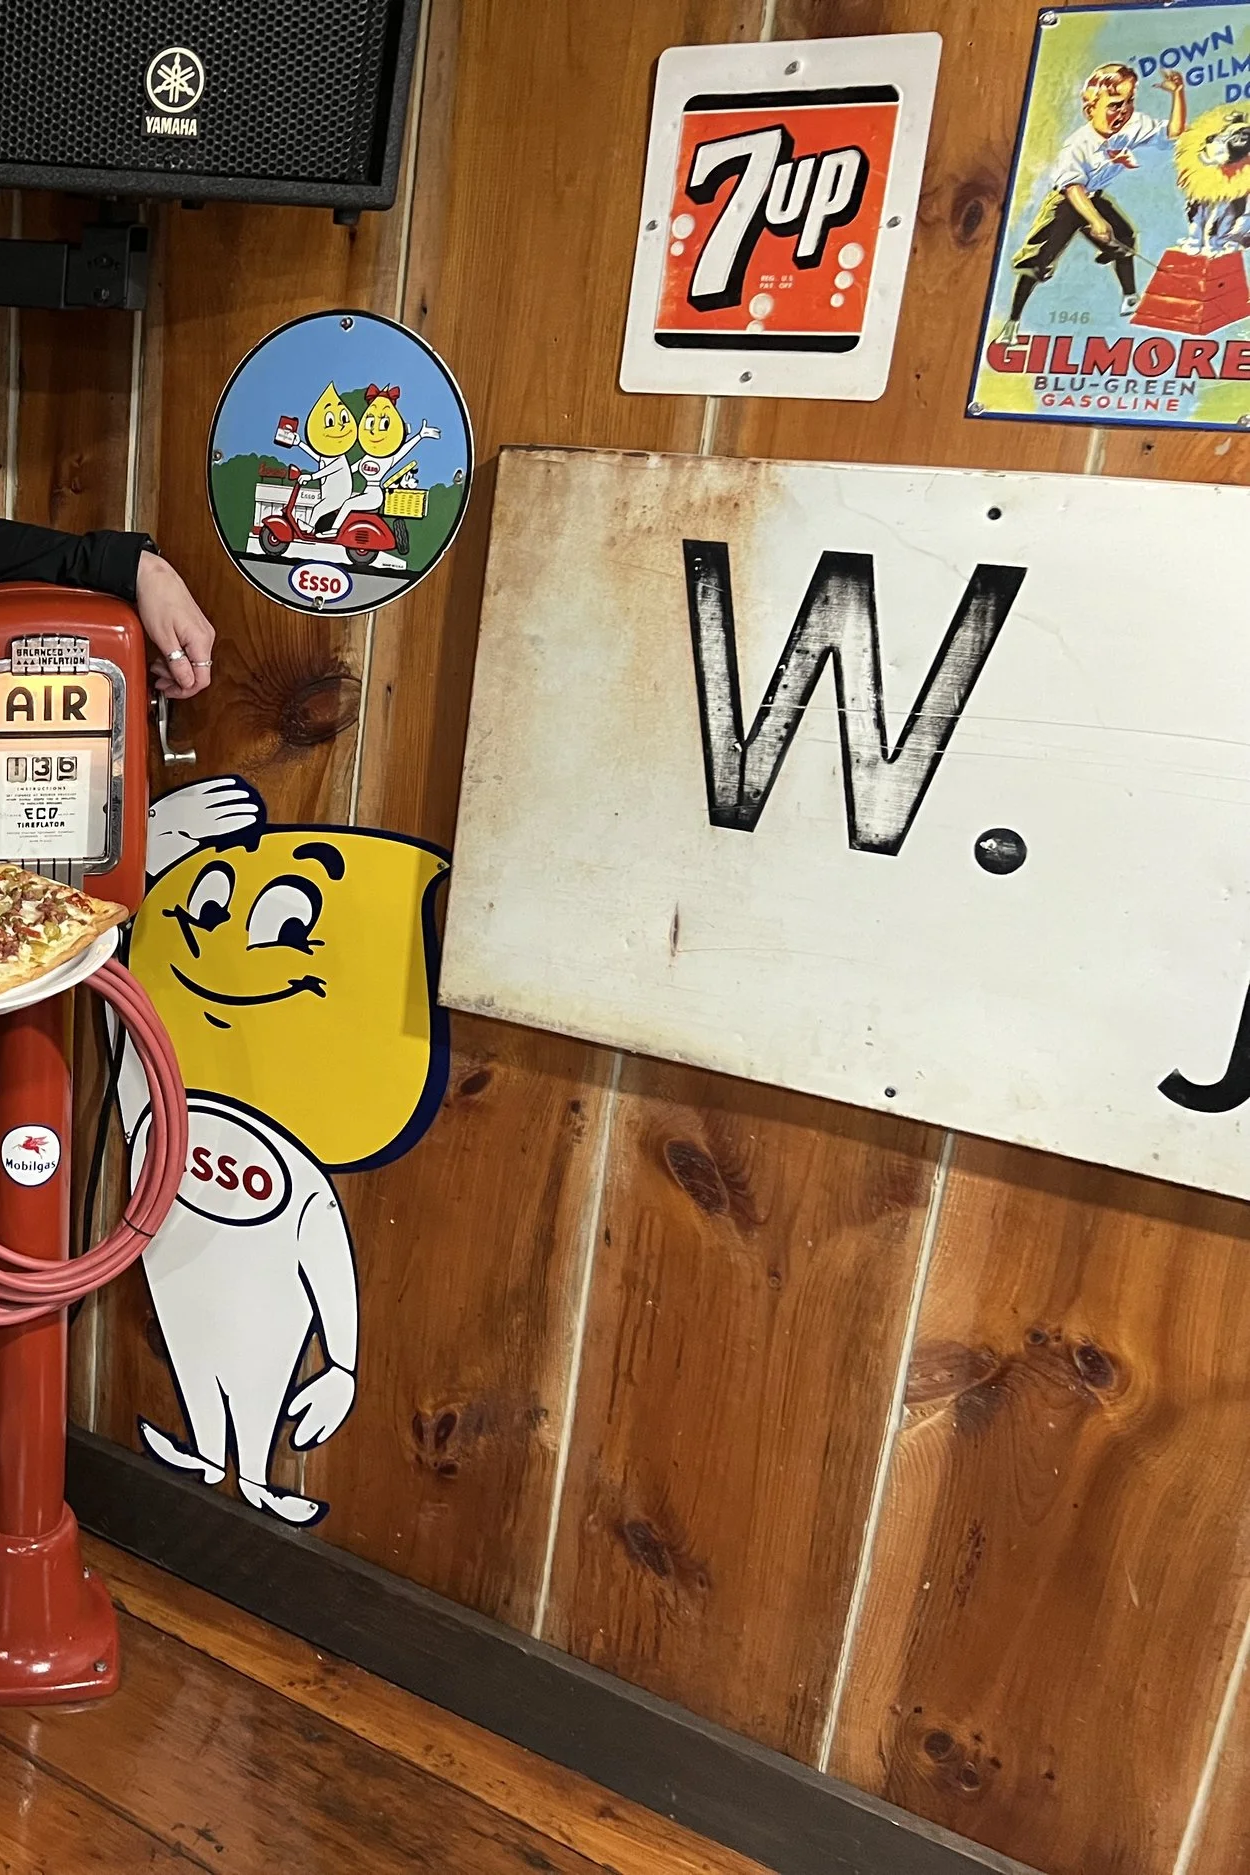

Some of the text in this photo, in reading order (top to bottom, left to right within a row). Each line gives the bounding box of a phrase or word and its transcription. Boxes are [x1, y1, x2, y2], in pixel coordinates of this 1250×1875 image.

[145, 116, 198, 136] YAMAHA
[1049, 311, 1091, 324] 1946
[986, 334, 1250, 381] GILMORE
[1034, 376, 1196, 396] BLU-GREEN
[1041, 393, 1180, 412] GASOLINE
[16, 648, 64, 657] BALANCED
[38, 656, 85, 665] INFLATION
[5, 685, 88, 722] AIR
[682, 538, 1028, 876] W.
[5, 1158, 56, 1174] Mobilgas
